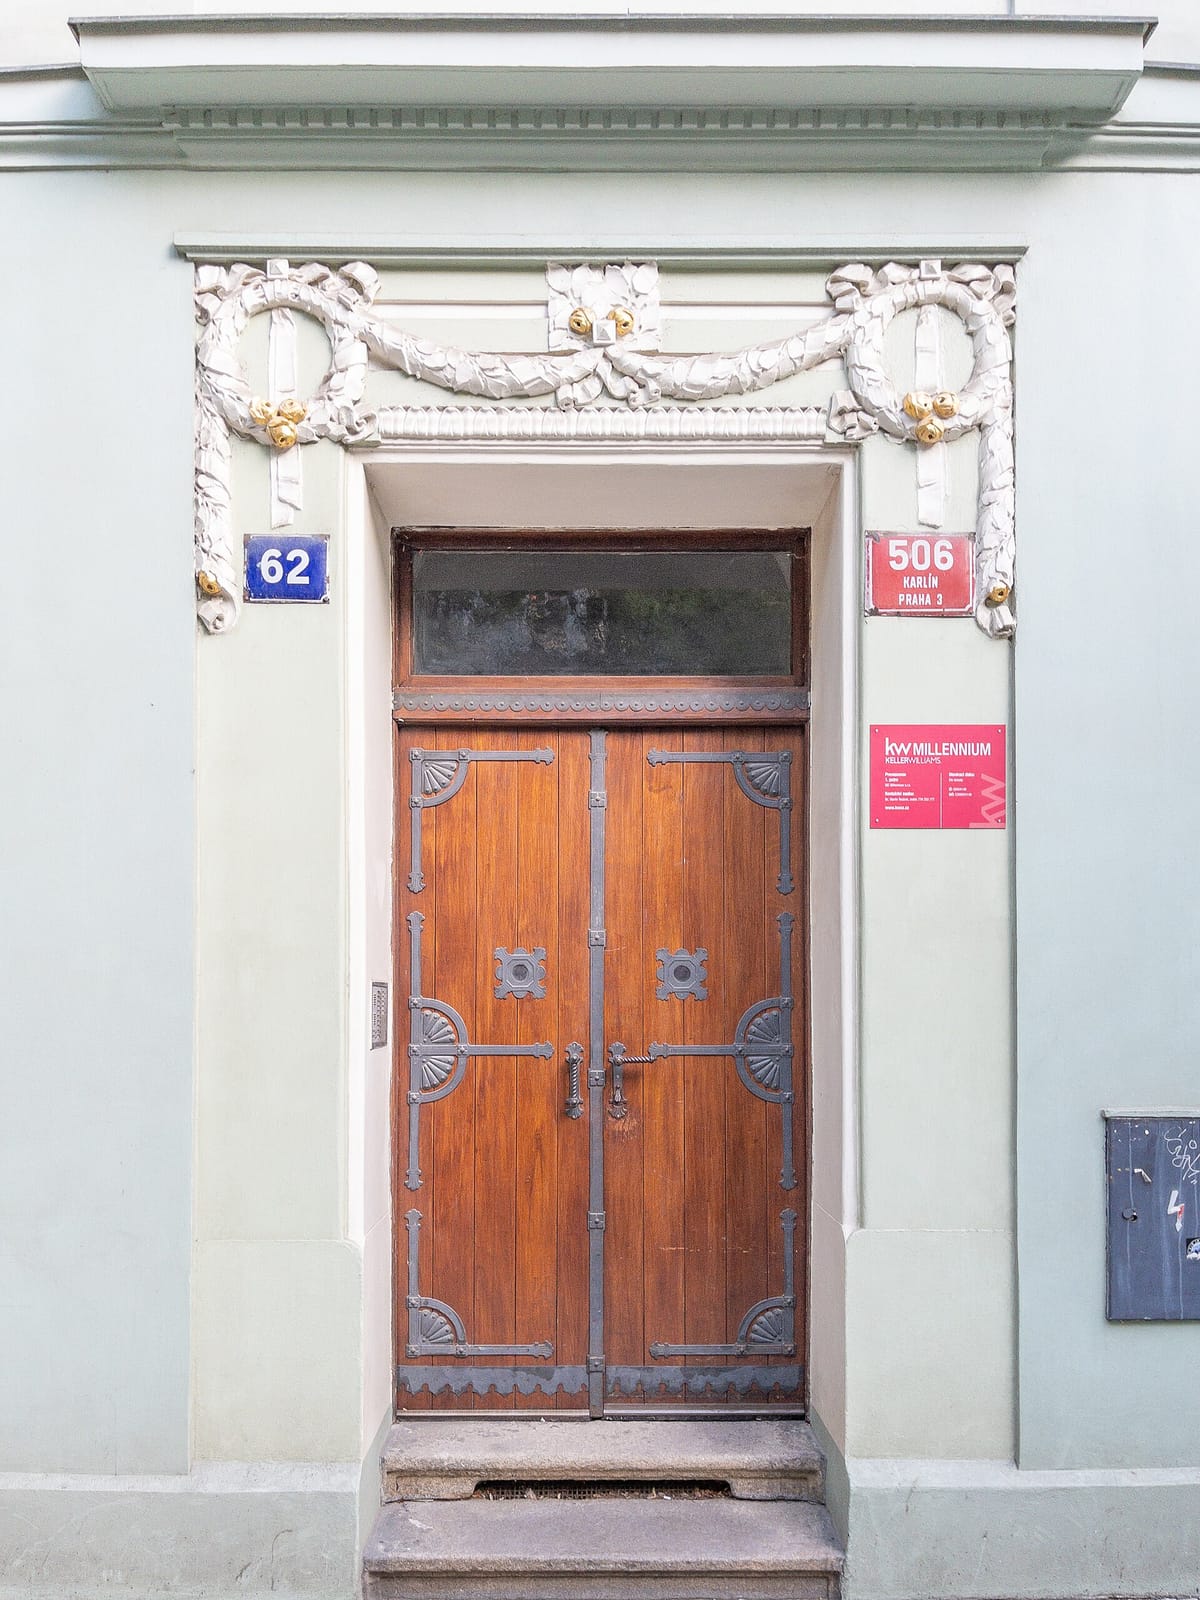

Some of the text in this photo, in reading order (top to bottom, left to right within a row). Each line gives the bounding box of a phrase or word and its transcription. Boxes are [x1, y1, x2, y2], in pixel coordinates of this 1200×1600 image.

[888, 539, 954, 571] 506
[260, 548, 310, 585] 62
[903, 573, 938, 588] KARLÍN
[898, 593, 943, 606] PRAHA 3
[913, 742, 991, 756] MILLENNIUM
